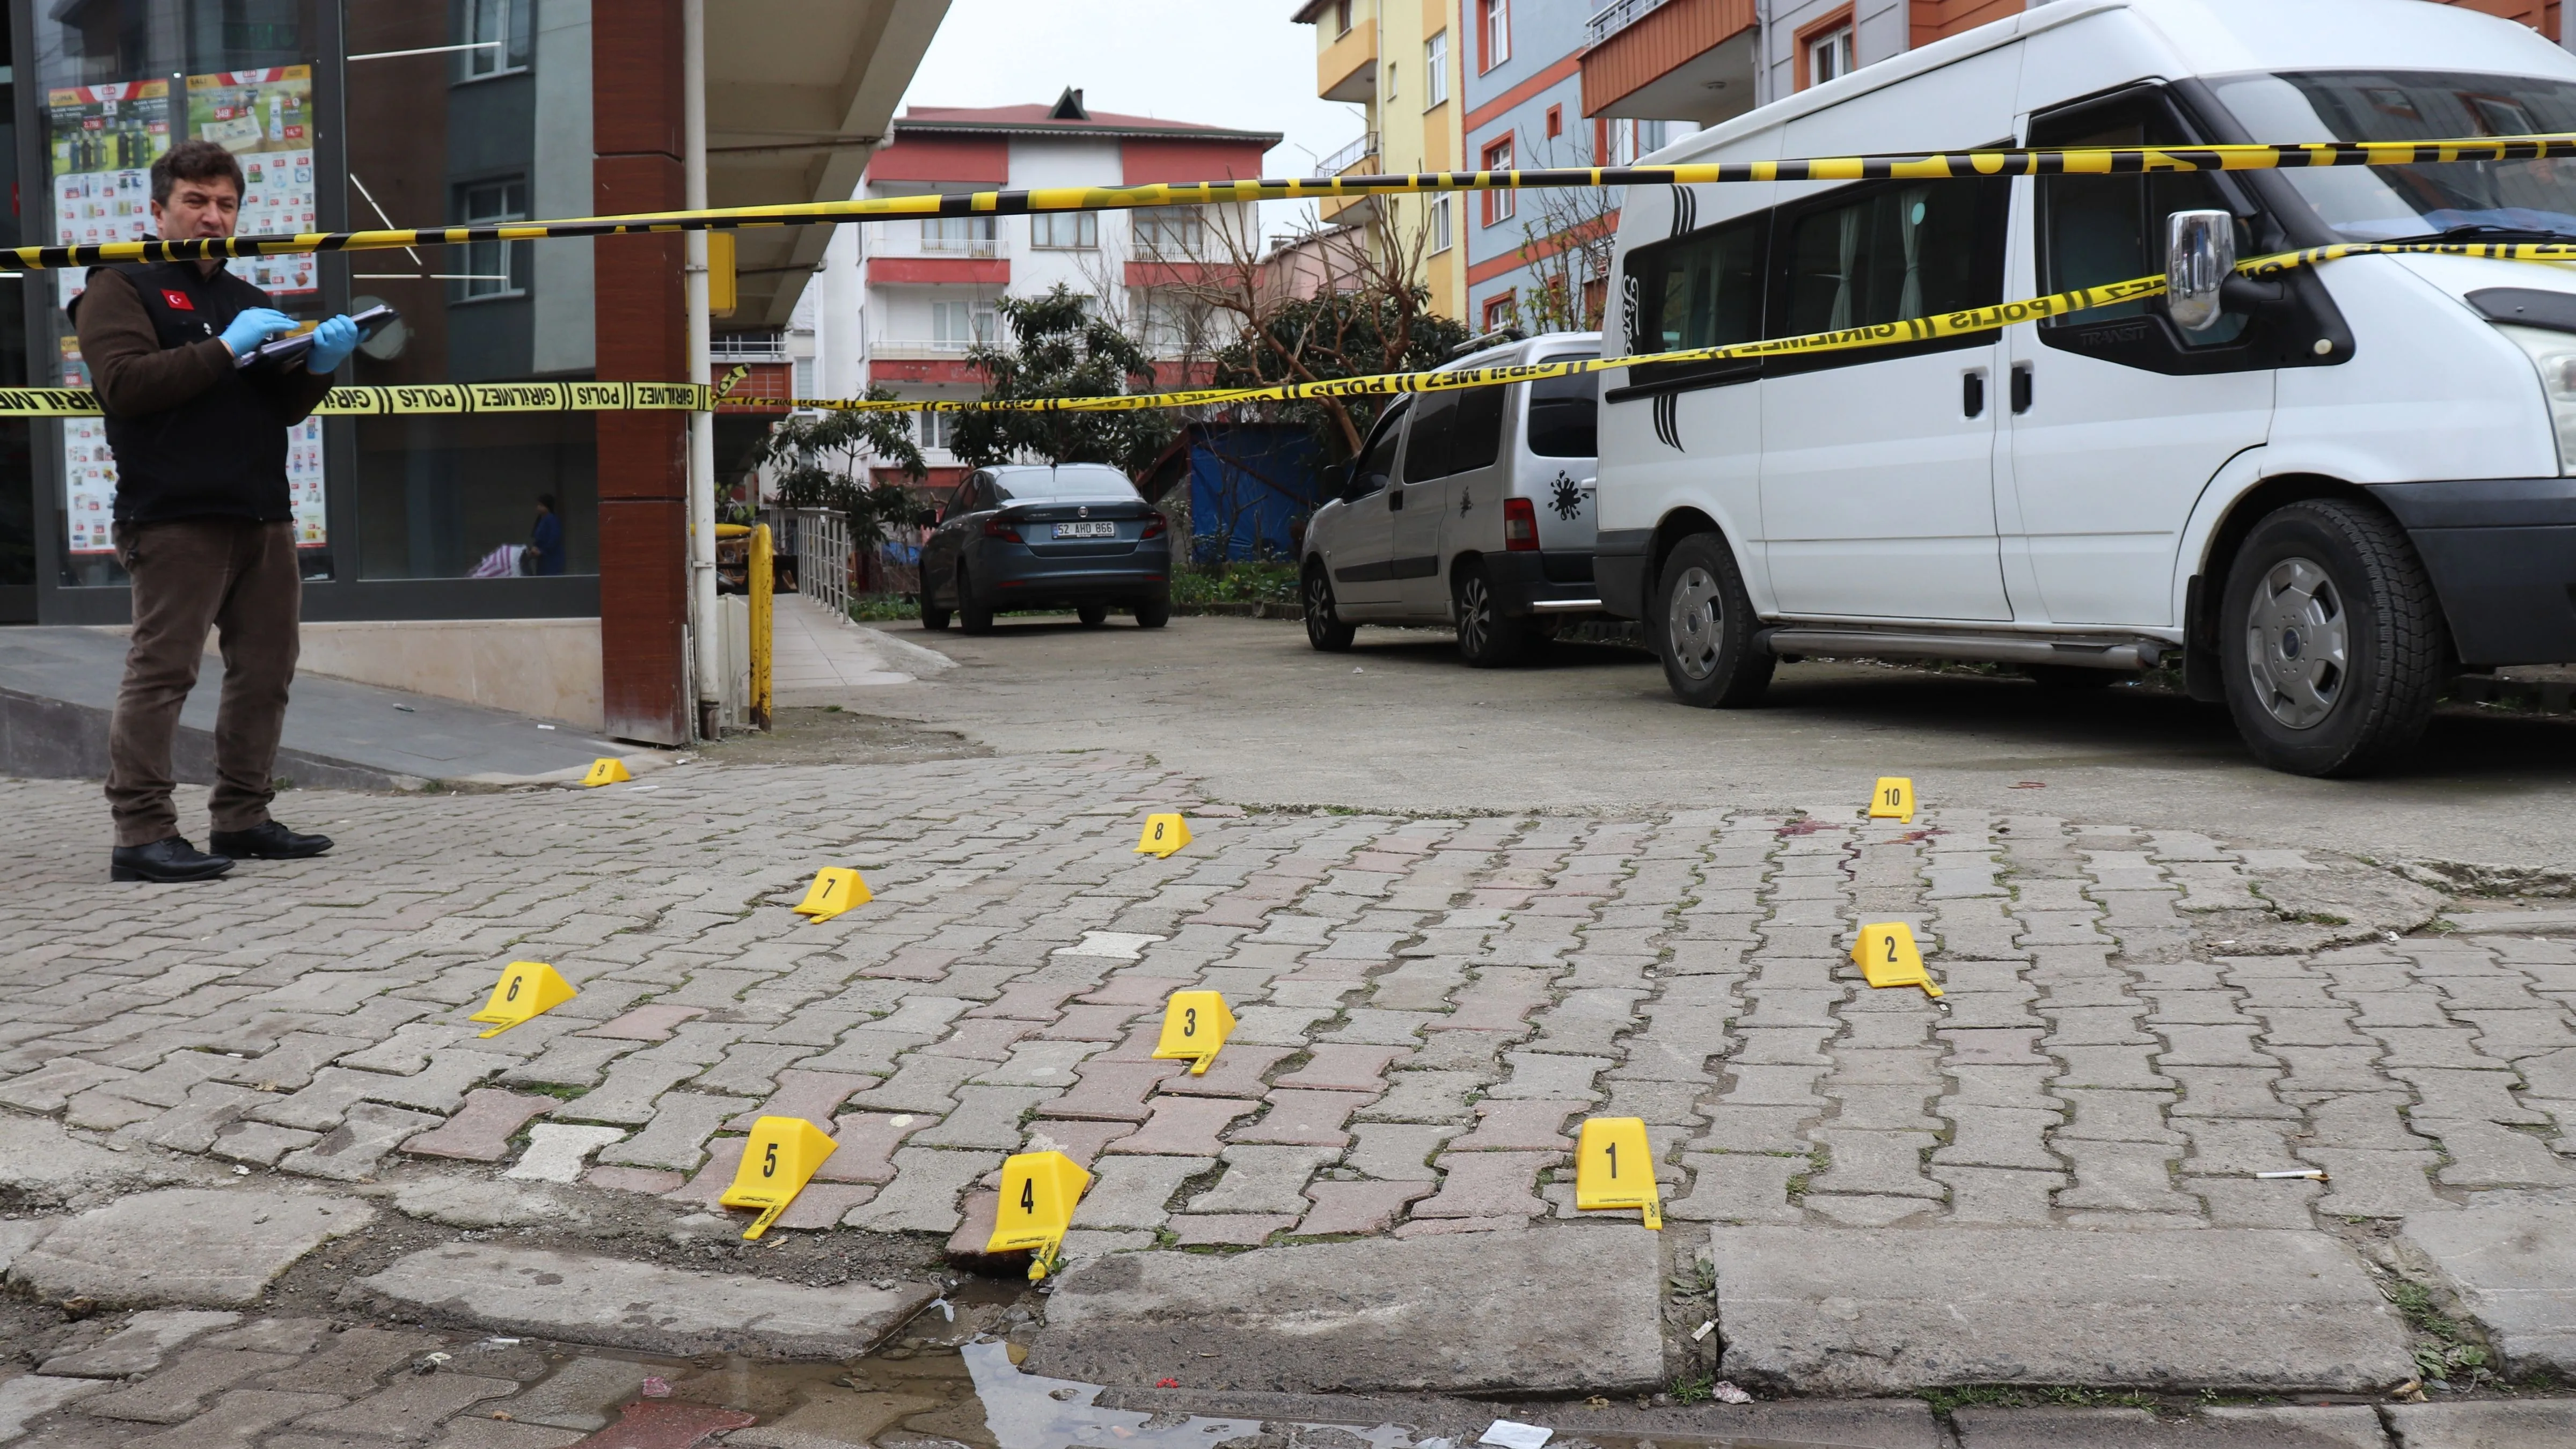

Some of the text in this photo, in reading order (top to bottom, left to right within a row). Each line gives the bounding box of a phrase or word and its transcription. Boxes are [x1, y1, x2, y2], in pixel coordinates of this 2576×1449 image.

[1058, 523, 1112, 534] 52 AHD 866
[597, 764, 605, 776] 9
[1884, 788, 1900, 806] 10
[1154, 822, 1163, 840] 8
[822, 879, 836, 898] 7
[1885, 936, 1898, 962] 2
[507, 976, 522, 1002] 6
[1184, 1008, 1196, 1037] 3
[763, 1143, 778, 1177] 5
[1606, 1142, 1616, 1179] 1
[1021, 1178, 1034, 1214] 4
